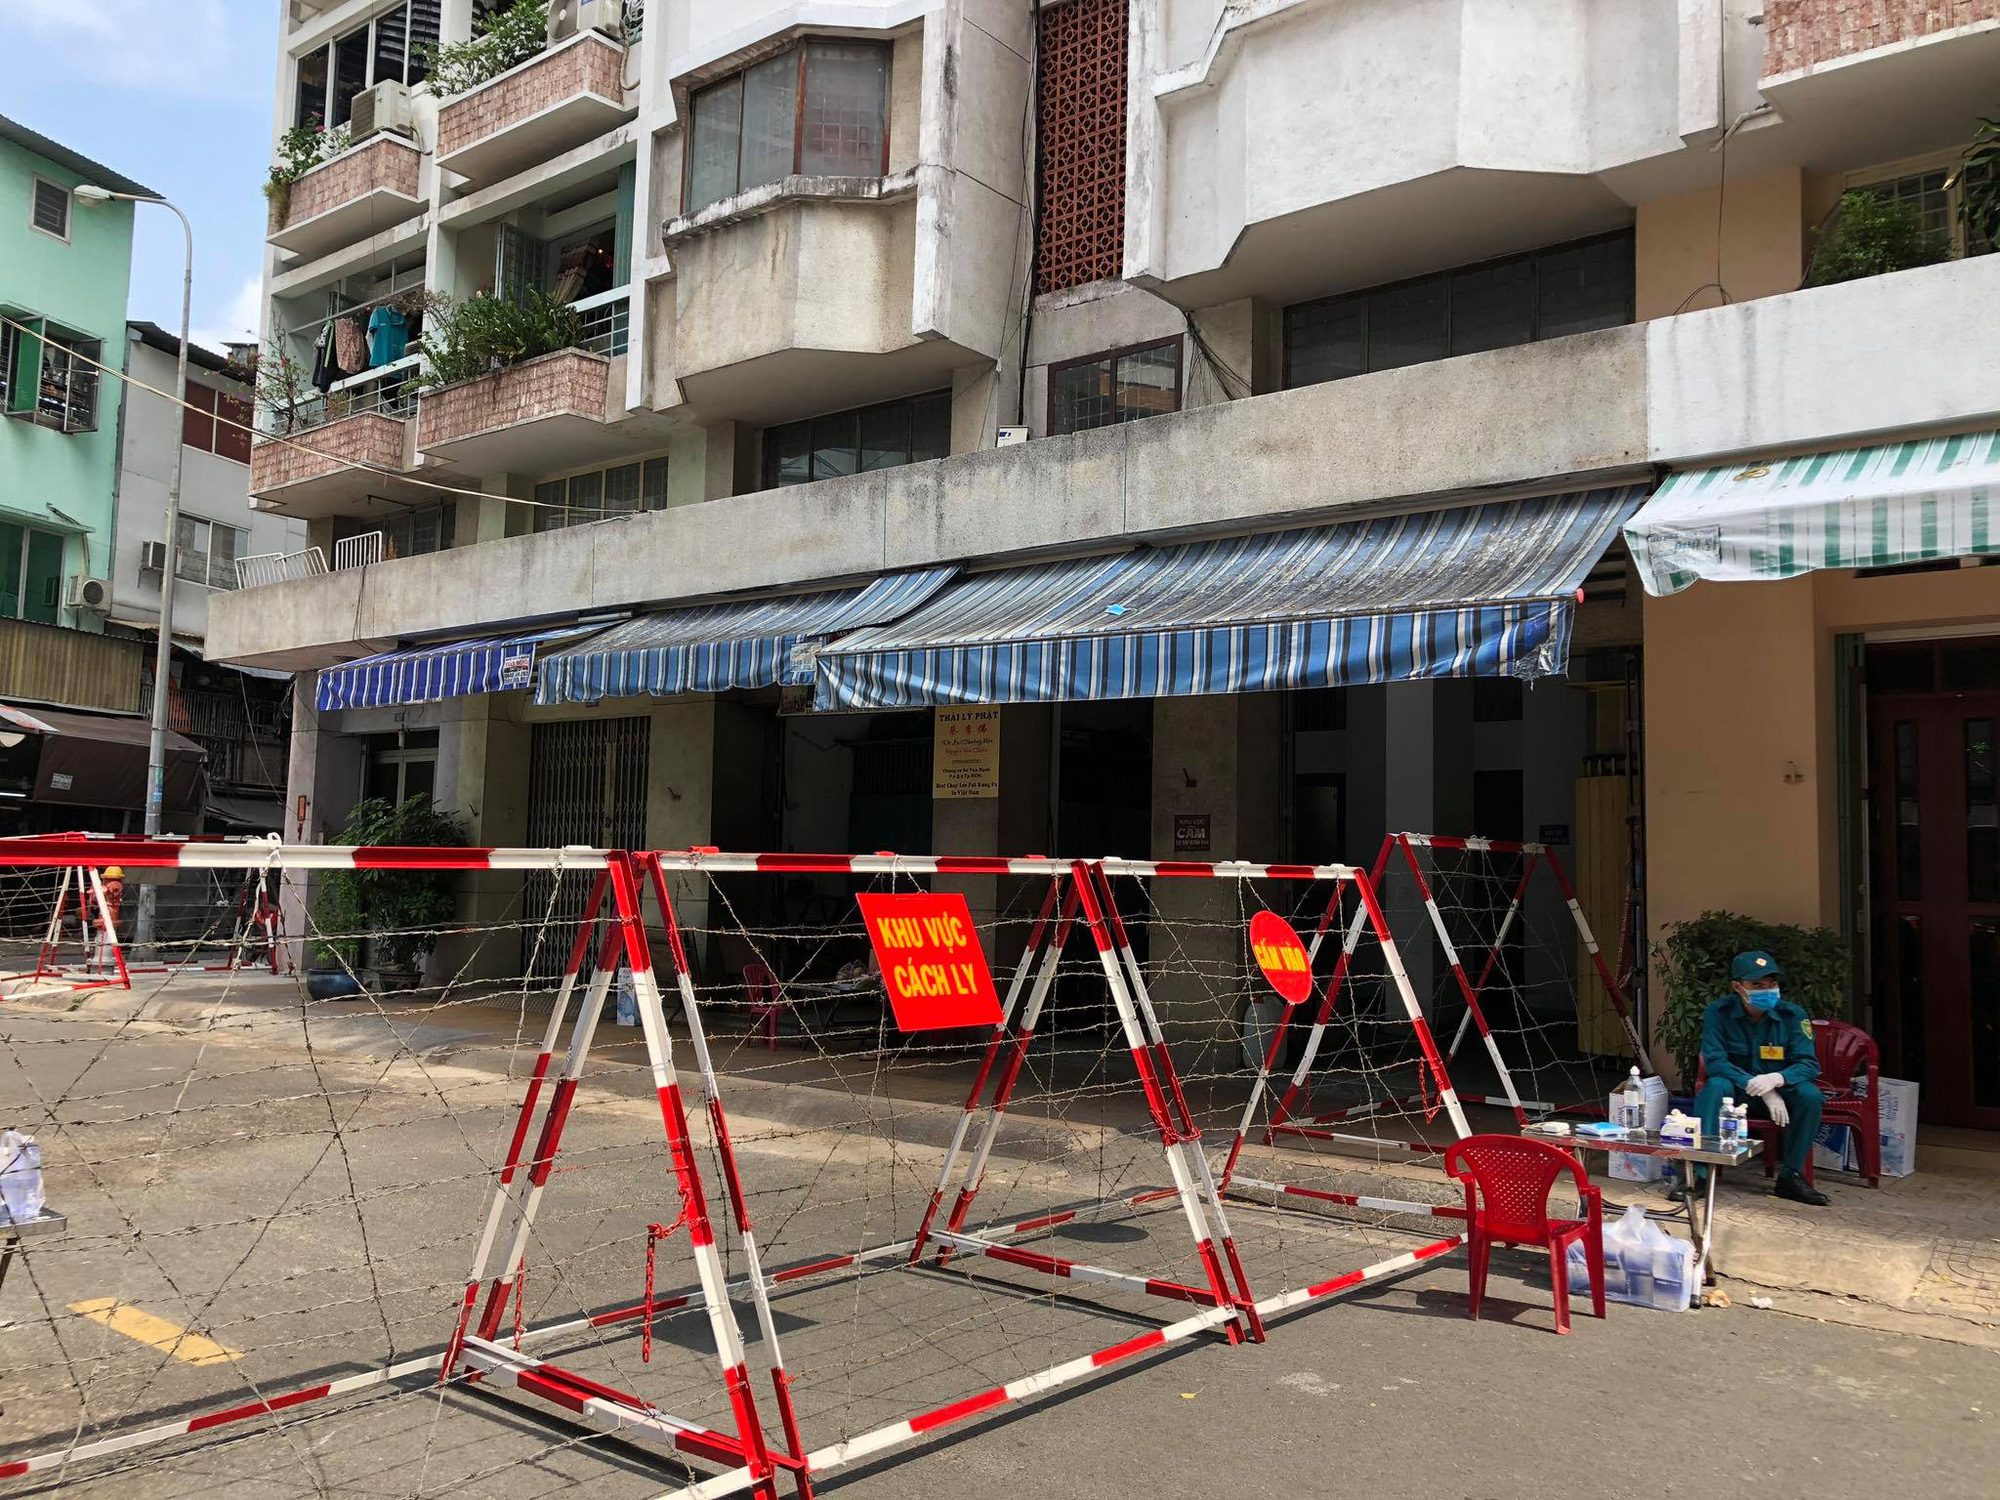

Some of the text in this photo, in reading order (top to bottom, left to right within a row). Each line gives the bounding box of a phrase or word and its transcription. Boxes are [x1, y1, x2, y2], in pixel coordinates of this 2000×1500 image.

[975, 710, 999, 721] PHẬT
[876, 911, 968, 954] KHU VỰC
[1253, 937, 1307, 972] CẤM VÀO
[893, 957, 978, 998] CÁCH LY
